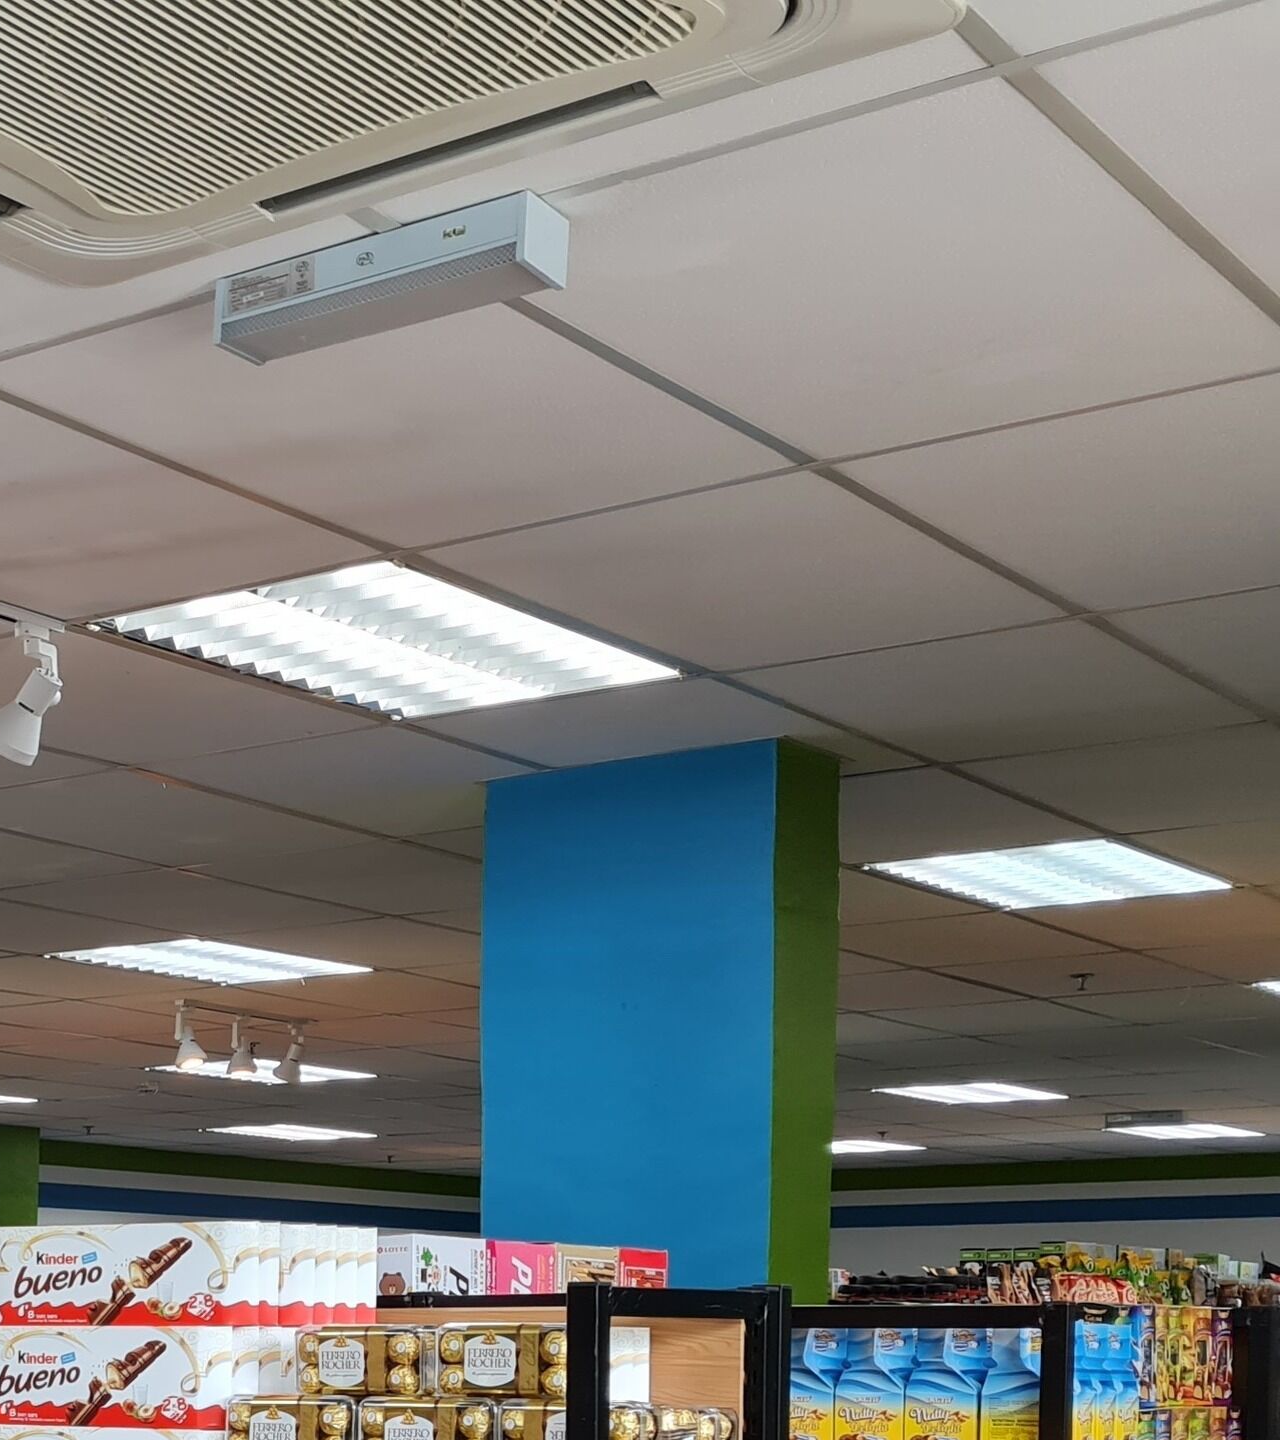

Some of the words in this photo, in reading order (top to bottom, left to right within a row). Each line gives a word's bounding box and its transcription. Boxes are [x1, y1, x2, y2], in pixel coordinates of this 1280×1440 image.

[36, 1252, 78, 1265] Kinder
[14, 1265, 102, 1298] bueno
[18, 1351, 57, 1364] Kinder
